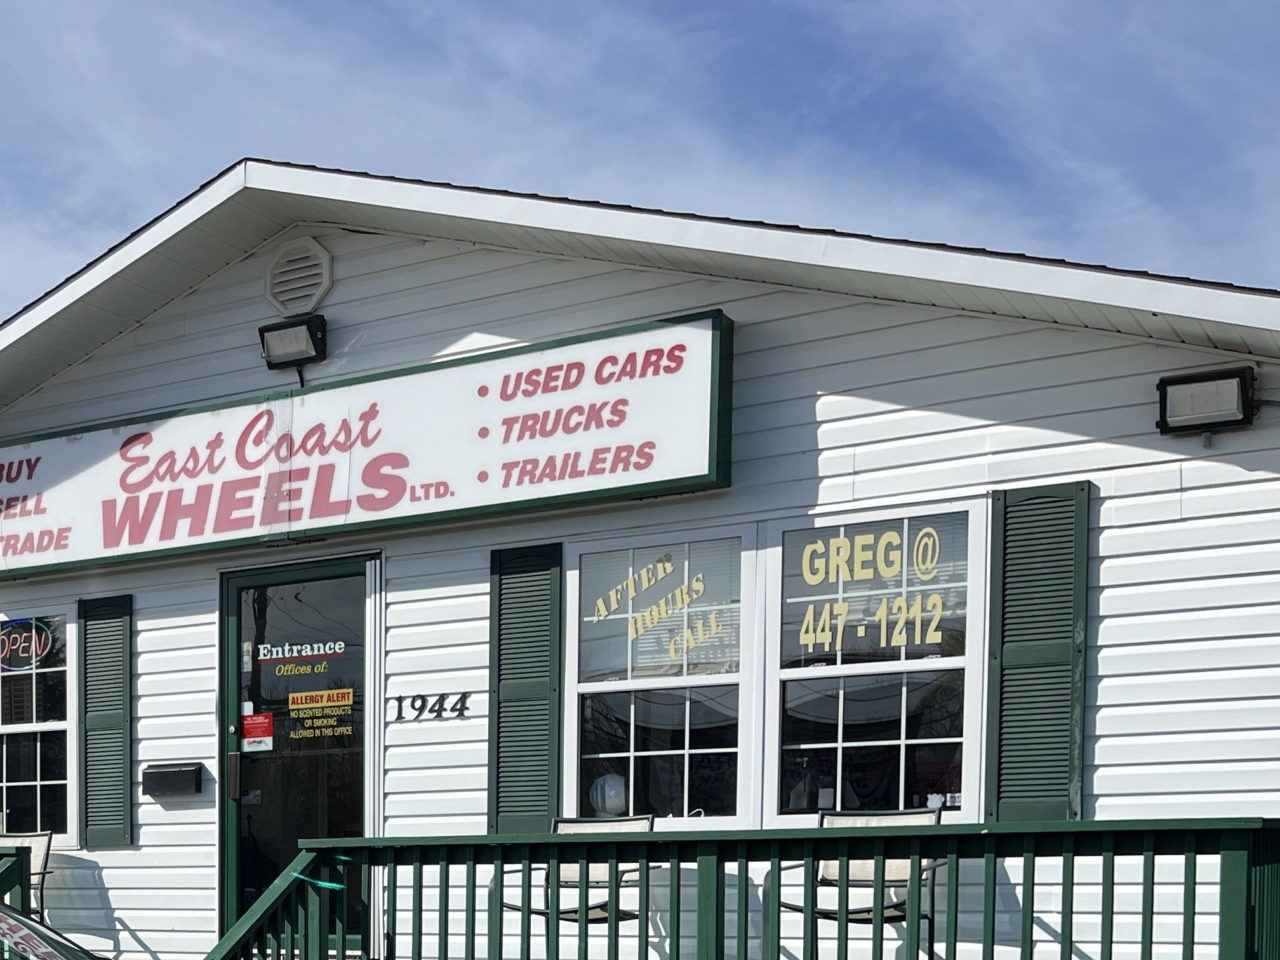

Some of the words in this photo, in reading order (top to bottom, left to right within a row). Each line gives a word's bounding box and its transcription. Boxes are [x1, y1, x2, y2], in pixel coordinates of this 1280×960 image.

[499, 361, 585, 401] USED
[594, 344, 687, 385] CARS
[501, 398, 629, 444] TRUCKS
[119, 431, 226, 494] East
[235, 402, 382, 471] Coast
[501, 441, 656, 488] TRAILERS
[102, 452, 410, 549] WHEELS
[410, 480, 455, 503] LTD.
[802, 531, 902, 586] GREG
[913, 527, 940, 581] @
[593, 553, 674, 624] AFTER
[629, 572, 705, 641] HOURS
[258, 640, 345, 660] Entrance
[669, 611, 723, 660] CALL
[275, 663, 312, 676] Offices
[290, 710, 298, 718] NO
[299, 709, 322, 718] SCENTED
[324, 707, 351, 716] PRODUCTS
[291, 694, 324, 706] ALLERGY
[327, 692, 351, 703] ALERT
[304, 719, 312, 727] OR
[313, 717, 337, 727] SMOKING
[395, 692, 471, 721] 1944
[290, 729, 314, 738] ALLOWED
[315, 728, 320, 737] IN
[321, 728, 333, 736] THIS
[334, 726, 352, 735] OFFICE
